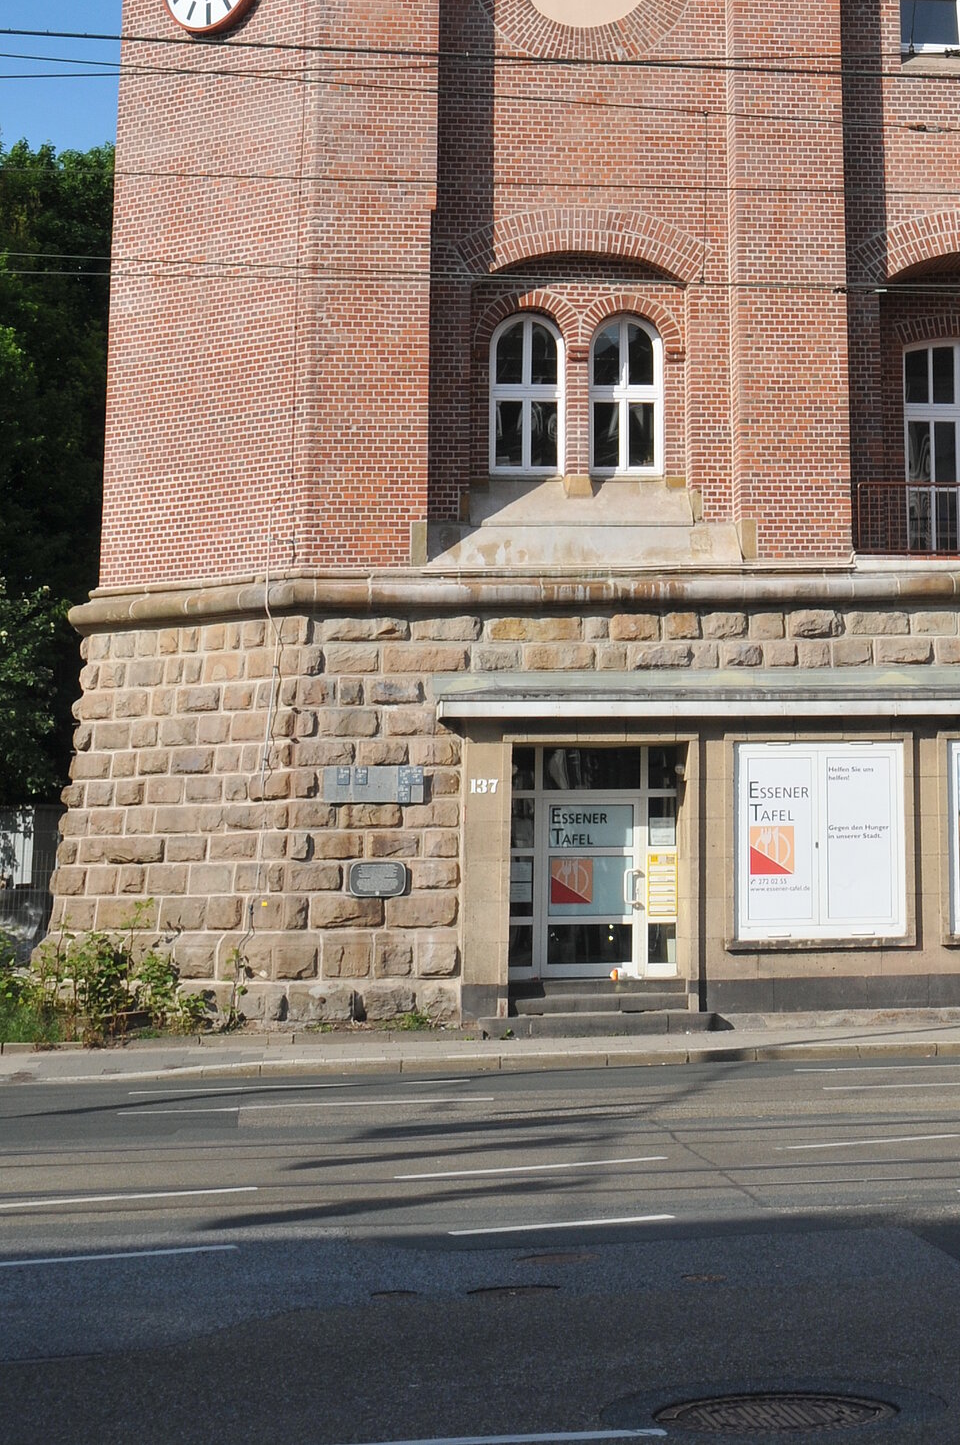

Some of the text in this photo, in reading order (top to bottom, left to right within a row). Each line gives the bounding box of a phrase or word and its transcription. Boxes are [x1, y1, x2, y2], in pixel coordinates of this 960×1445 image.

[470, 778, 499, 794] 137
[750, 804, 794, 821] TAFEL
[828, 824, 850, 832] Gegen
[865, 824, 889, 832] Hunger
[552, 828, 594, 845] TAFEL
